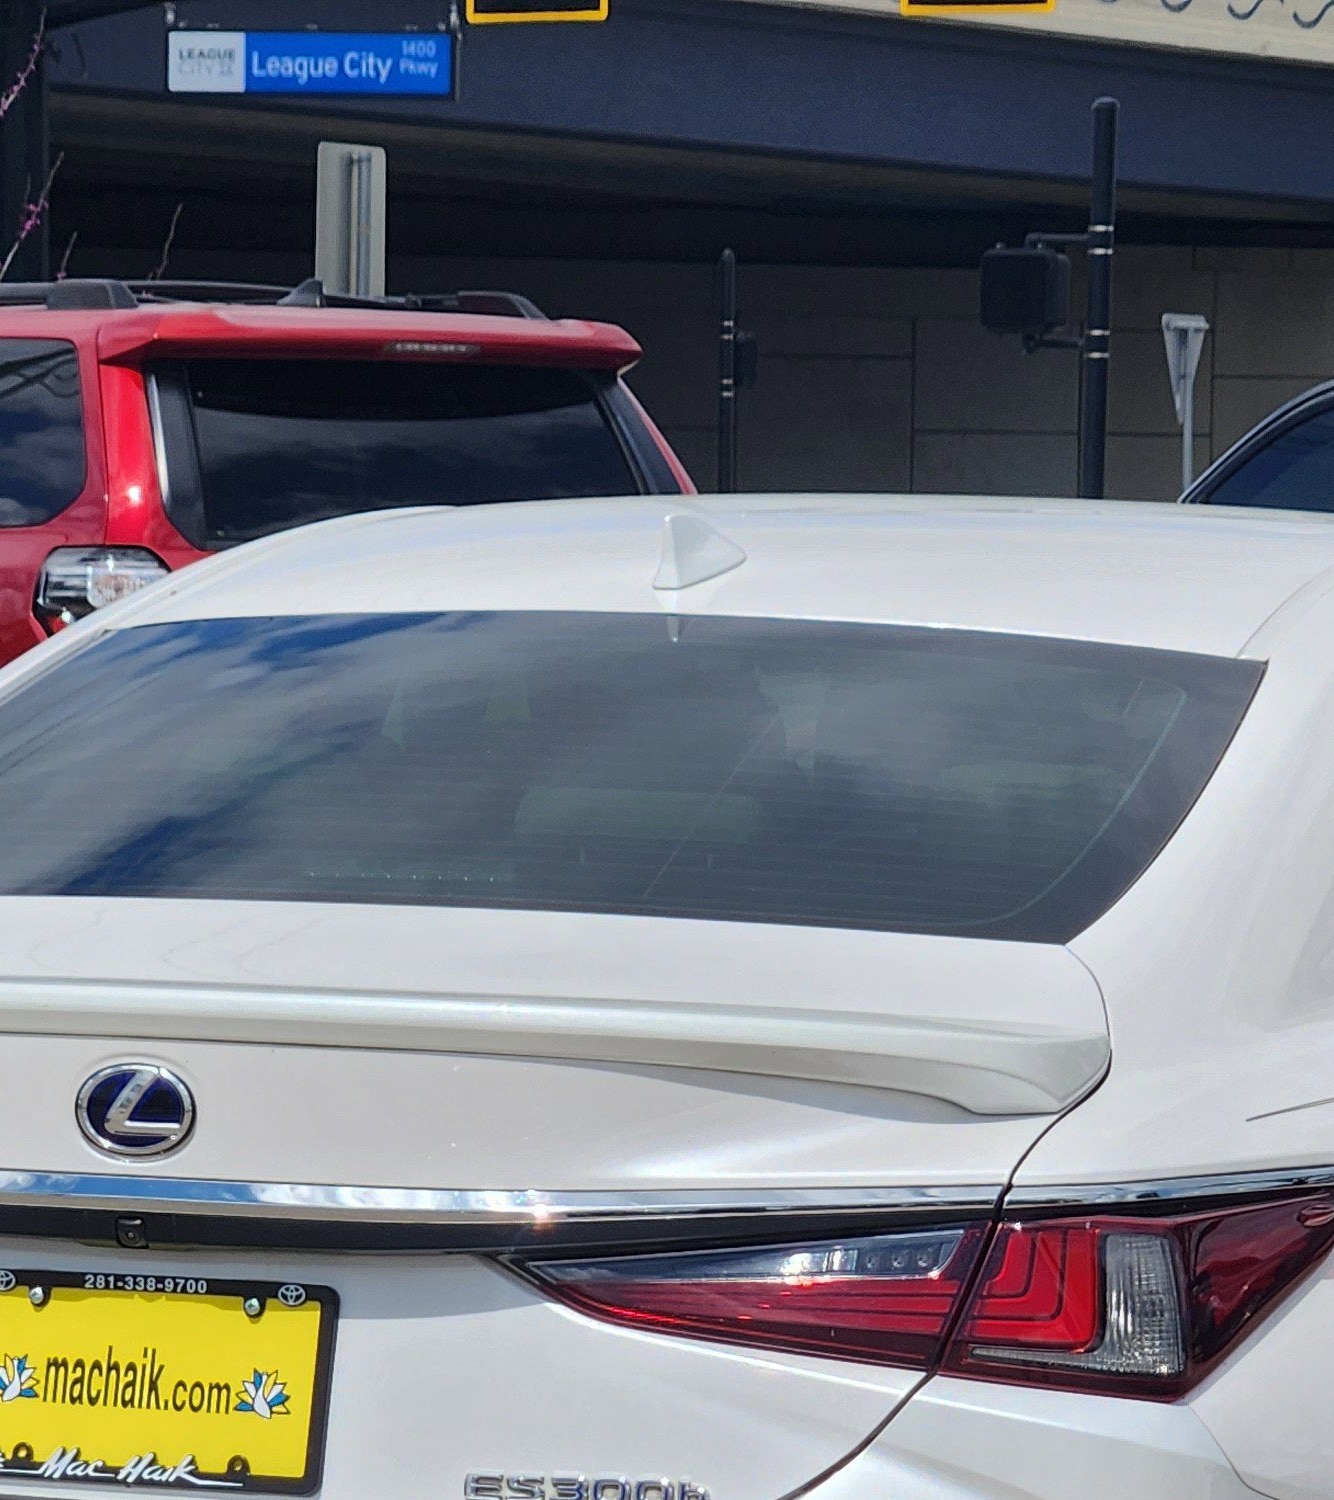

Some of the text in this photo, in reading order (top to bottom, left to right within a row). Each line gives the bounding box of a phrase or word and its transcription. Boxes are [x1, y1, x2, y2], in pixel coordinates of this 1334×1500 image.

[178, 47, 235, 60] LEAGUE
[251, 50, 393, 85] League City
[400, 58, 438, 78] Pkwy
[83, 1274, 209, 1295] 281-338-9700
[42, 1345, 232, 1416] machaik.com
[17, 1446, 114, 1480] Mac
